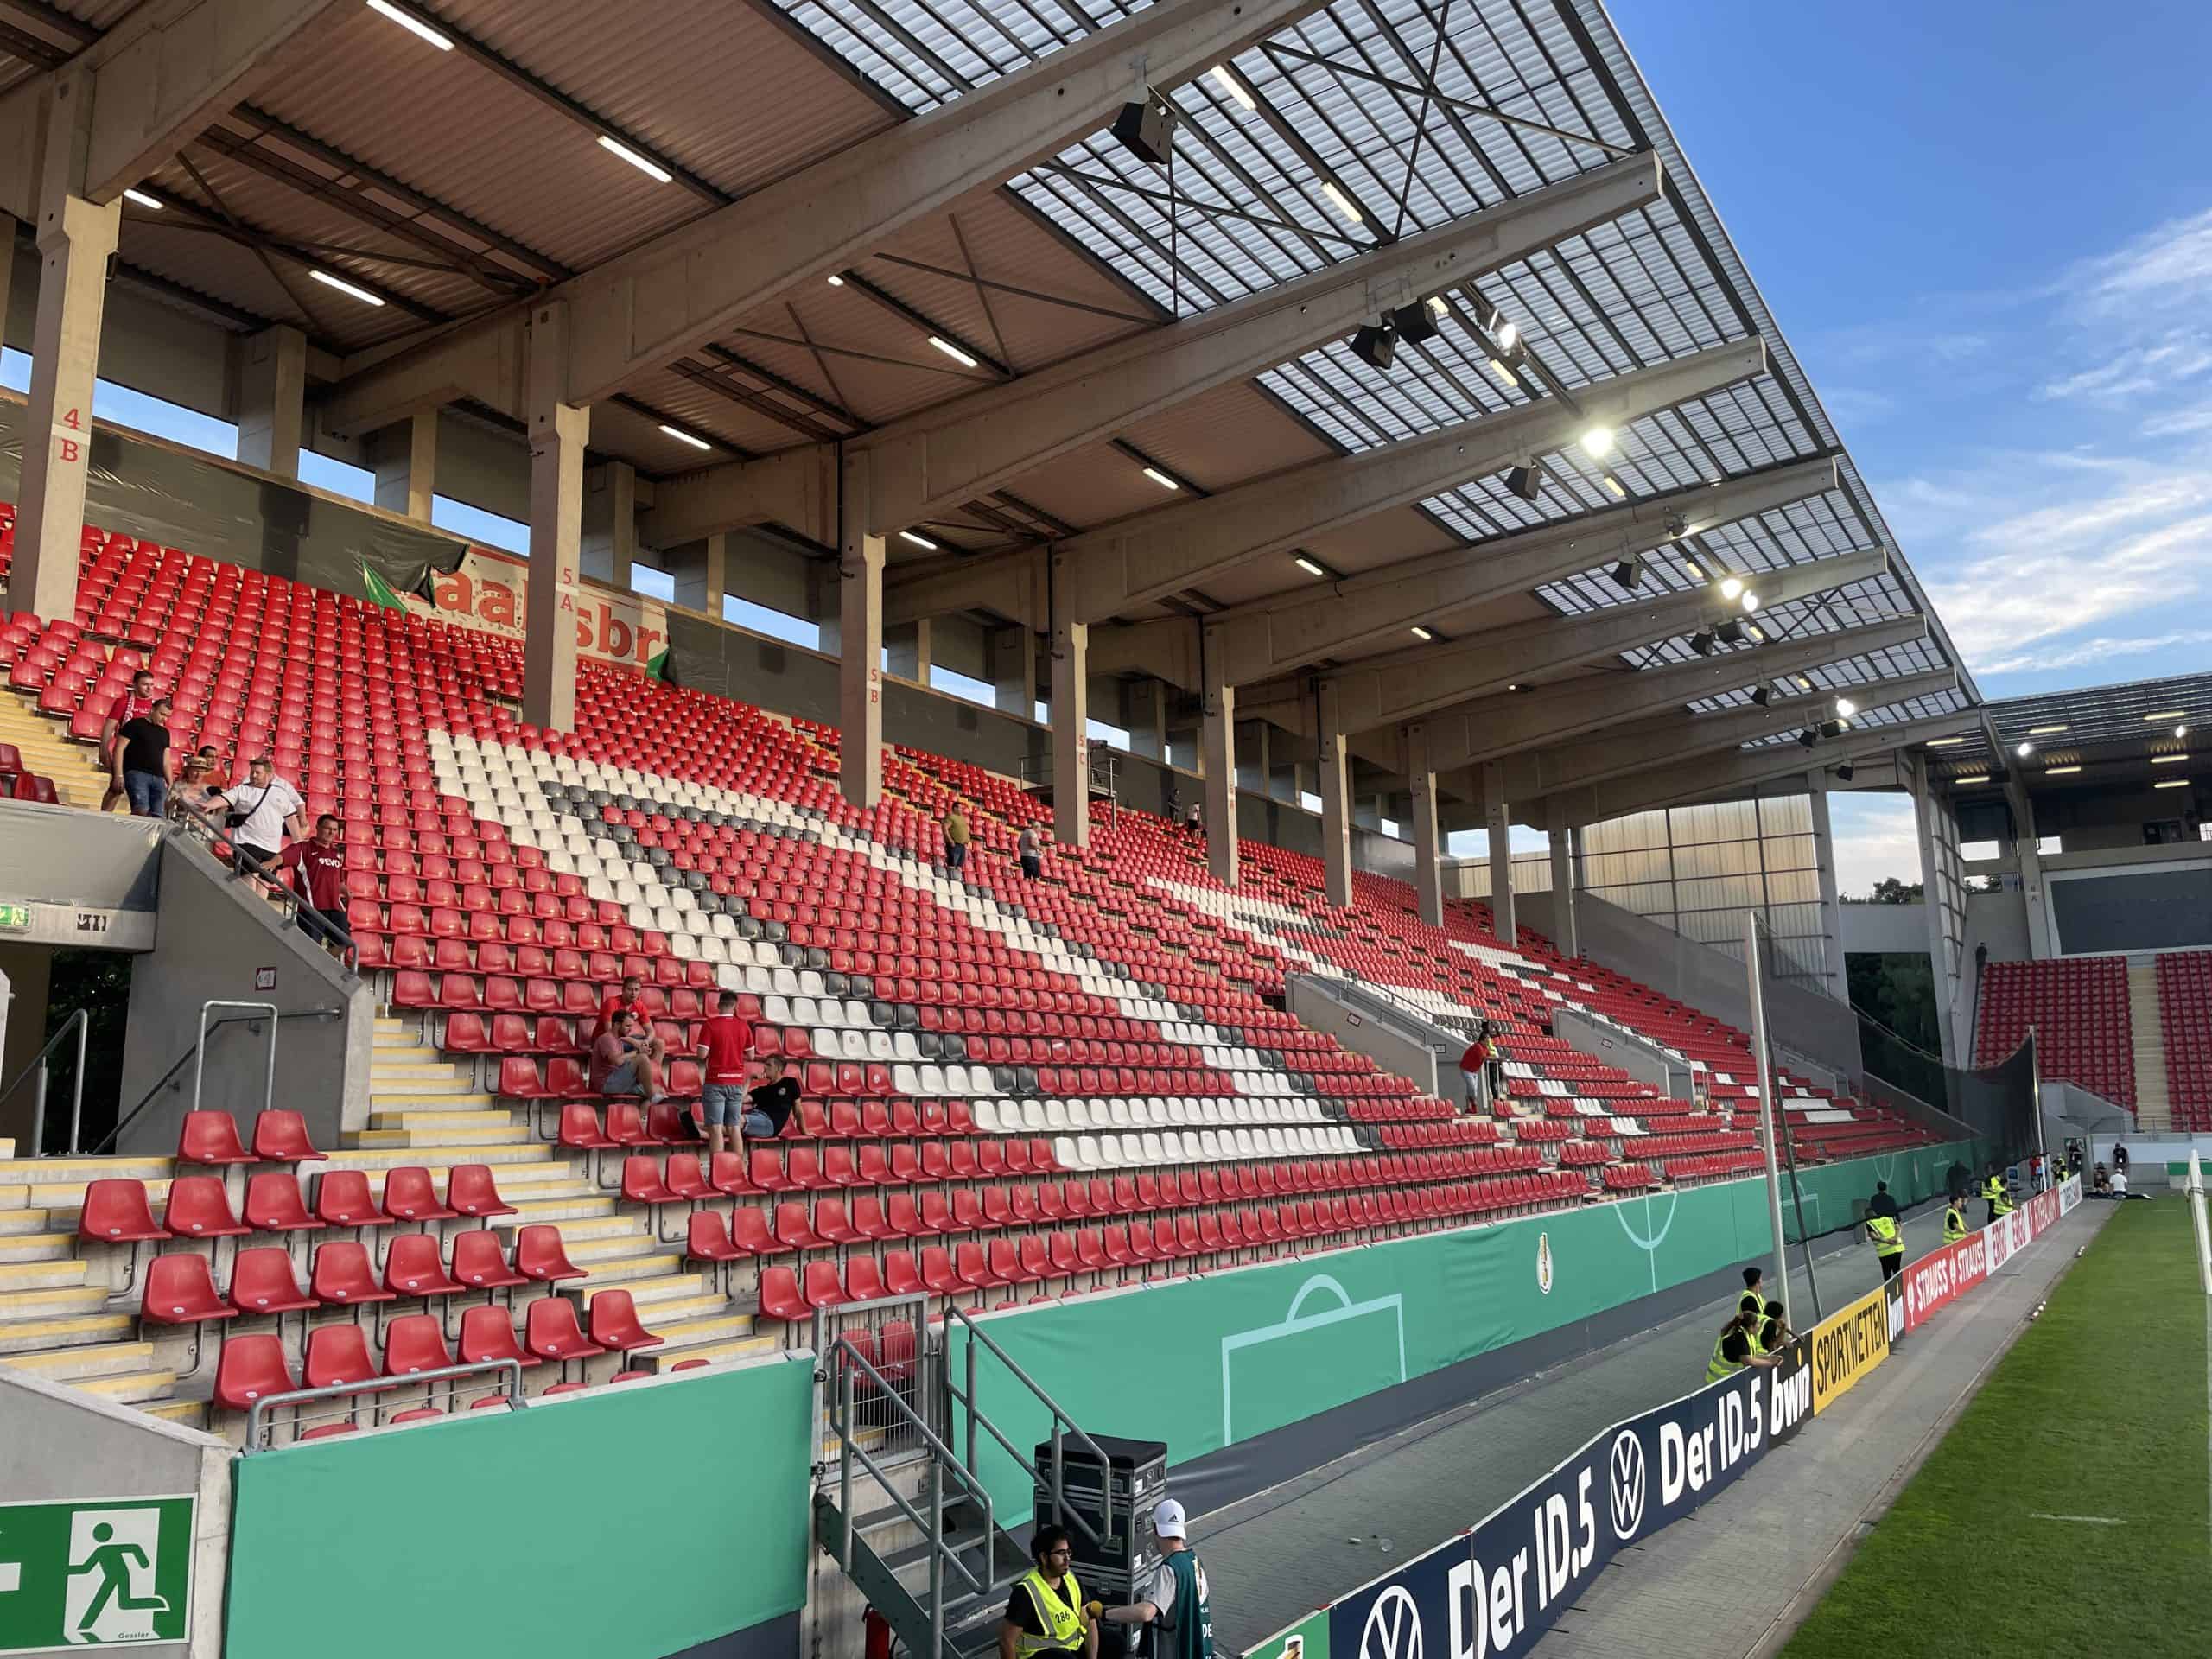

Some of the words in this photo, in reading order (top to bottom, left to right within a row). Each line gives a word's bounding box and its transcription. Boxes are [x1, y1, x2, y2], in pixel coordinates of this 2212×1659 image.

[63, 408, 81, 430] 4
[60, 438, 78, 462] B
[563, 567, 572, 584] 5
[561, 594, 573, 613] A
[870, 690, 878, 703] B
[1916, 1258, 1948, 1313] STRAUSS
[1816, 1299, 1885, 1397] SPORTWETTEN
[1770, 1347, 1810, 1436] bwin
[1660, 1421, 1713, 1507] Der
[1719, 1376, 1763, 1472] ID.5
[1448, 1546, 1528, 1659] Der
[1534, 1465, 1596, 1611] ID.5
